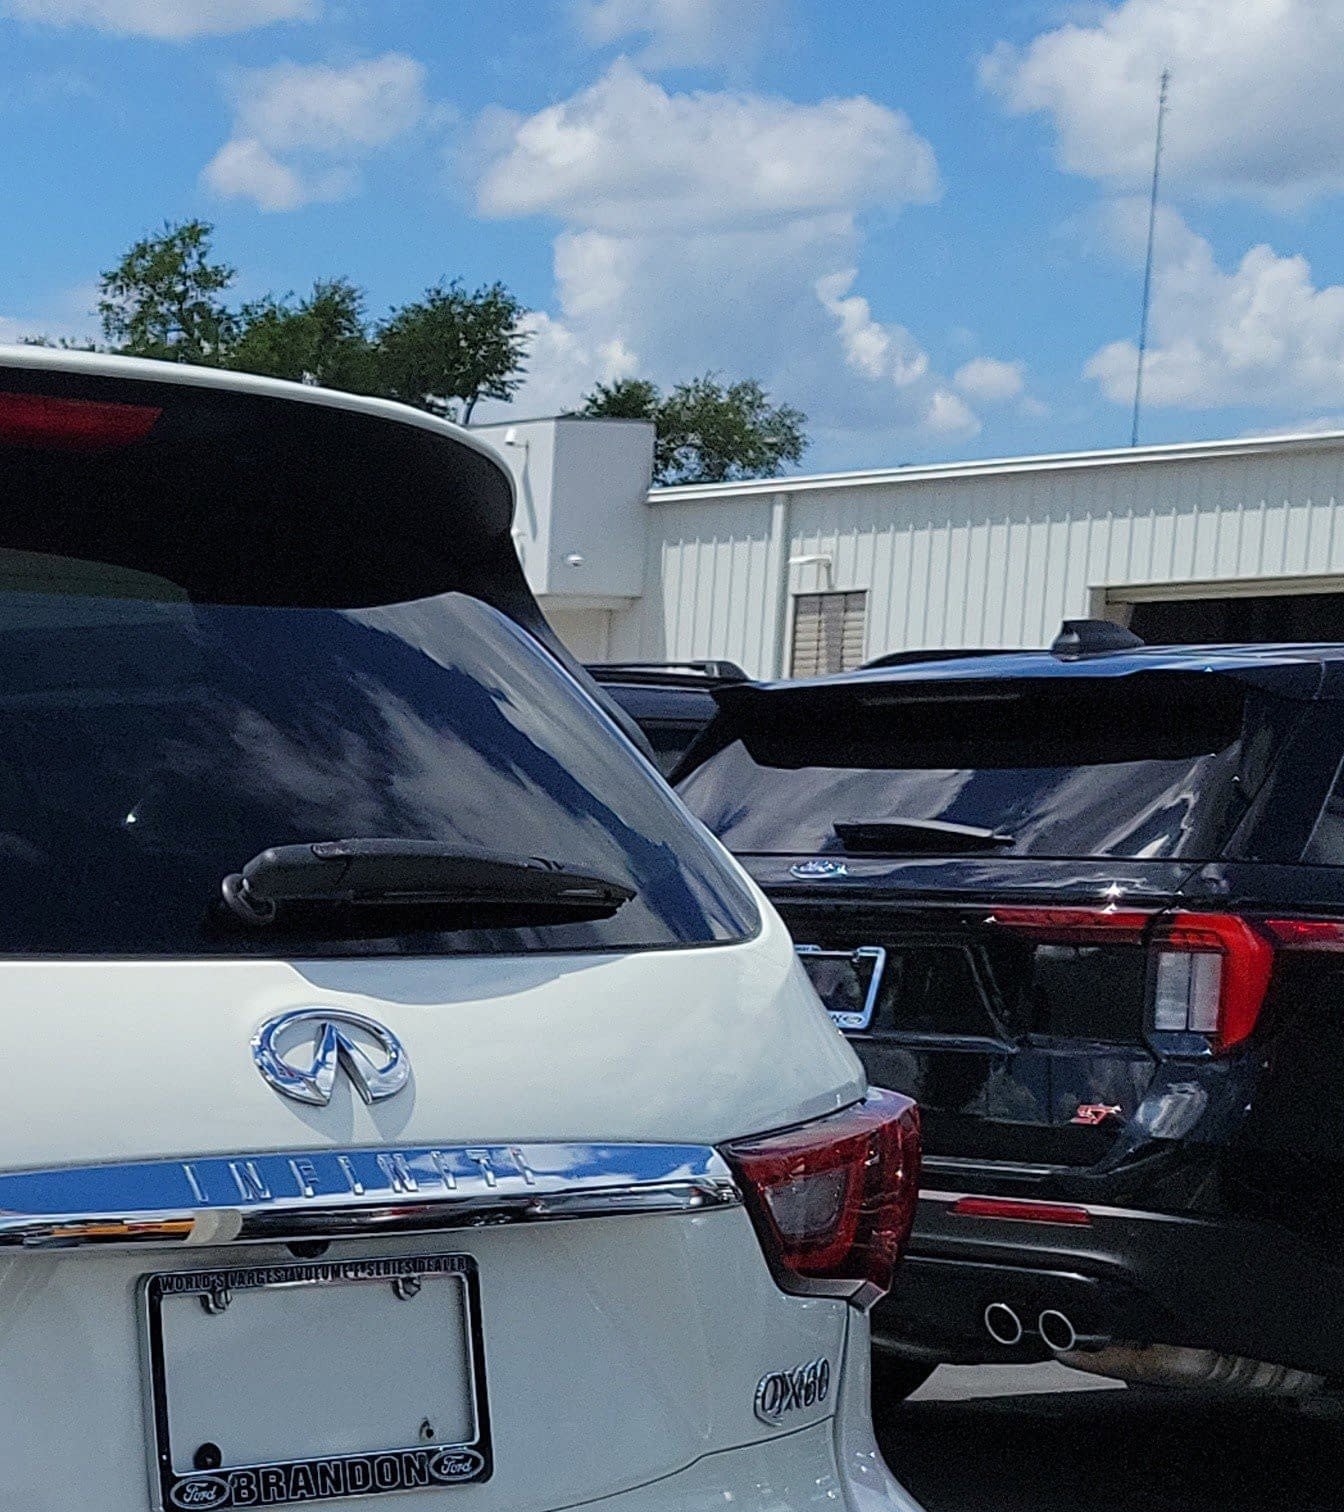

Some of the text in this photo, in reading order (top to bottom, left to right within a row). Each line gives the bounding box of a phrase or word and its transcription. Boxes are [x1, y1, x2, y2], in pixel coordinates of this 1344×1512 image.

[181, 1147, 536, 1203] INFINITI
[159, 1273, 225, 1294] WORLD'S
[182, 1450, 473, 1508] Ford BRANDON Ford
